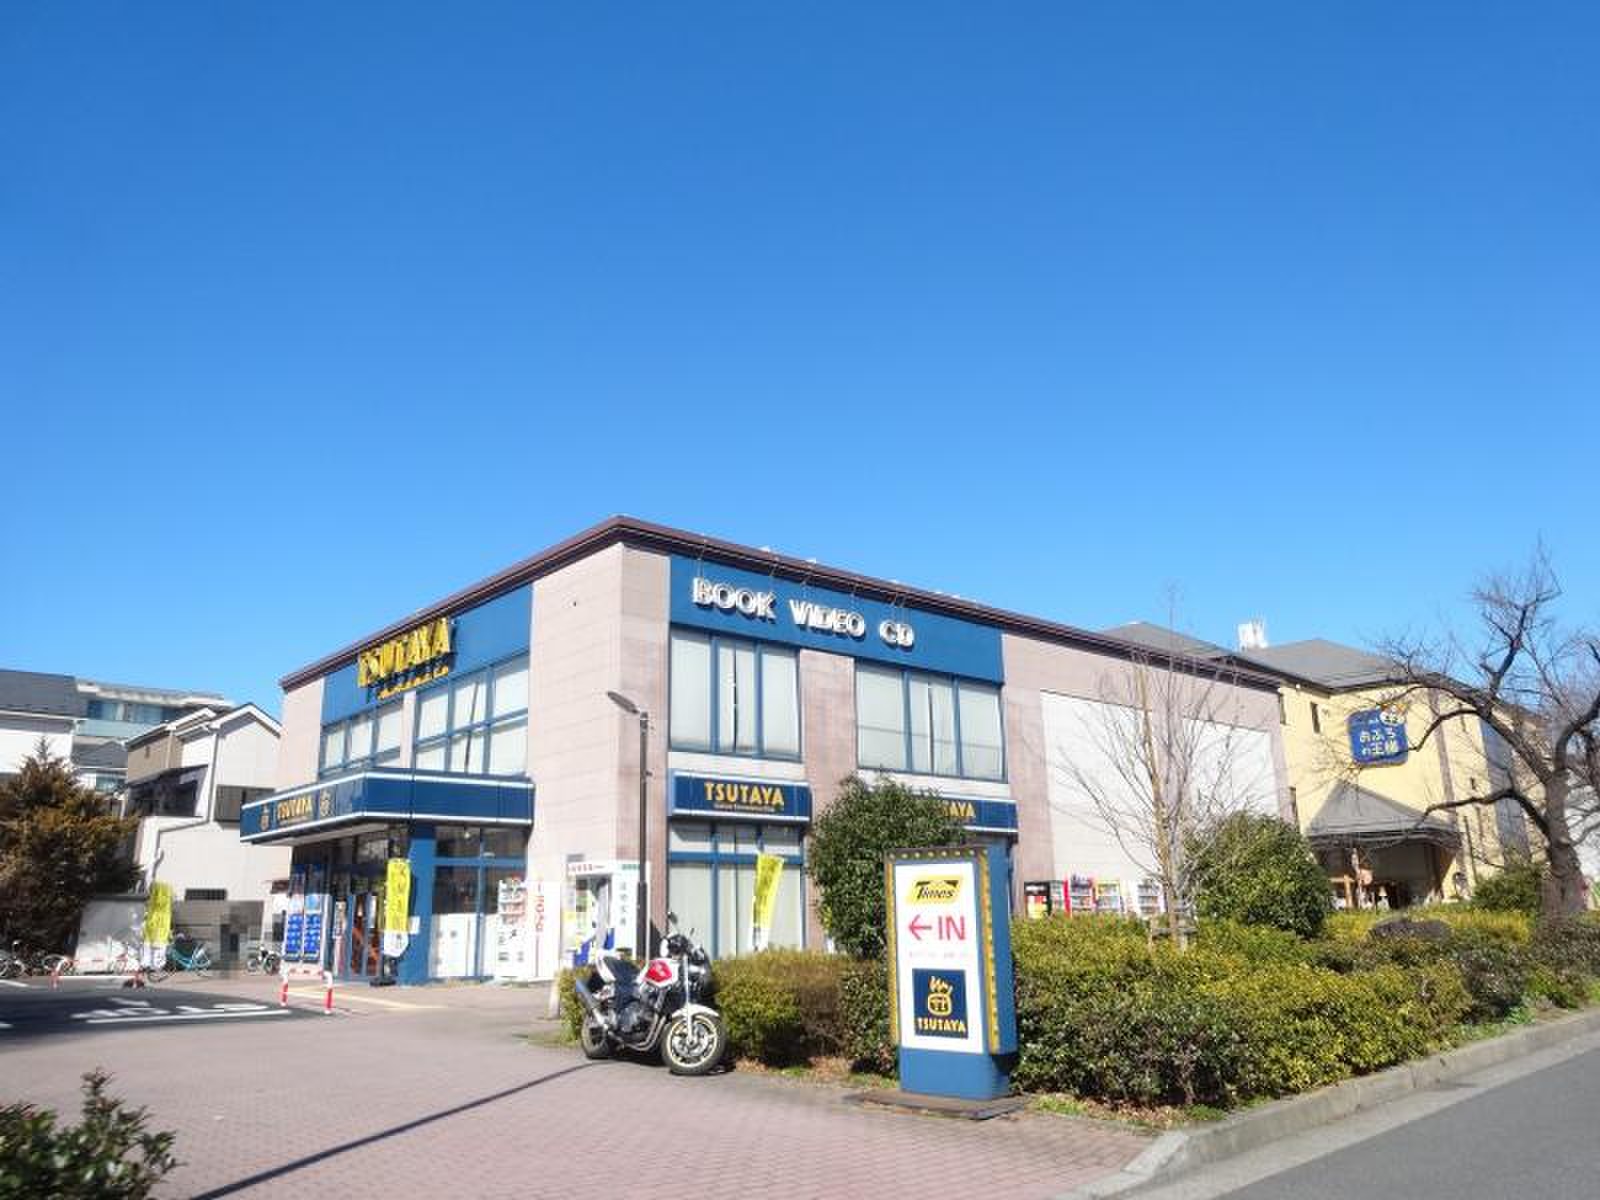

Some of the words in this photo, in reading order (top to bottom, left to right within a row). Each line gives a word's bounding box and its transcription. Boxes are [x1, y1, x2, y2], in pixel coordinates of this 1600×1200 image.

[692, 577, 776, 621] BOOK
[789, 598, 866, 639] VIDEO
[880, 618, 915, 649] CD
[705, 782, 784, 806] TSUTAYA
[915, 880, 959, 900] Times
[938, 915, 966, 941] IN
[918, 1017, 966, 1033] TSUTAYA
